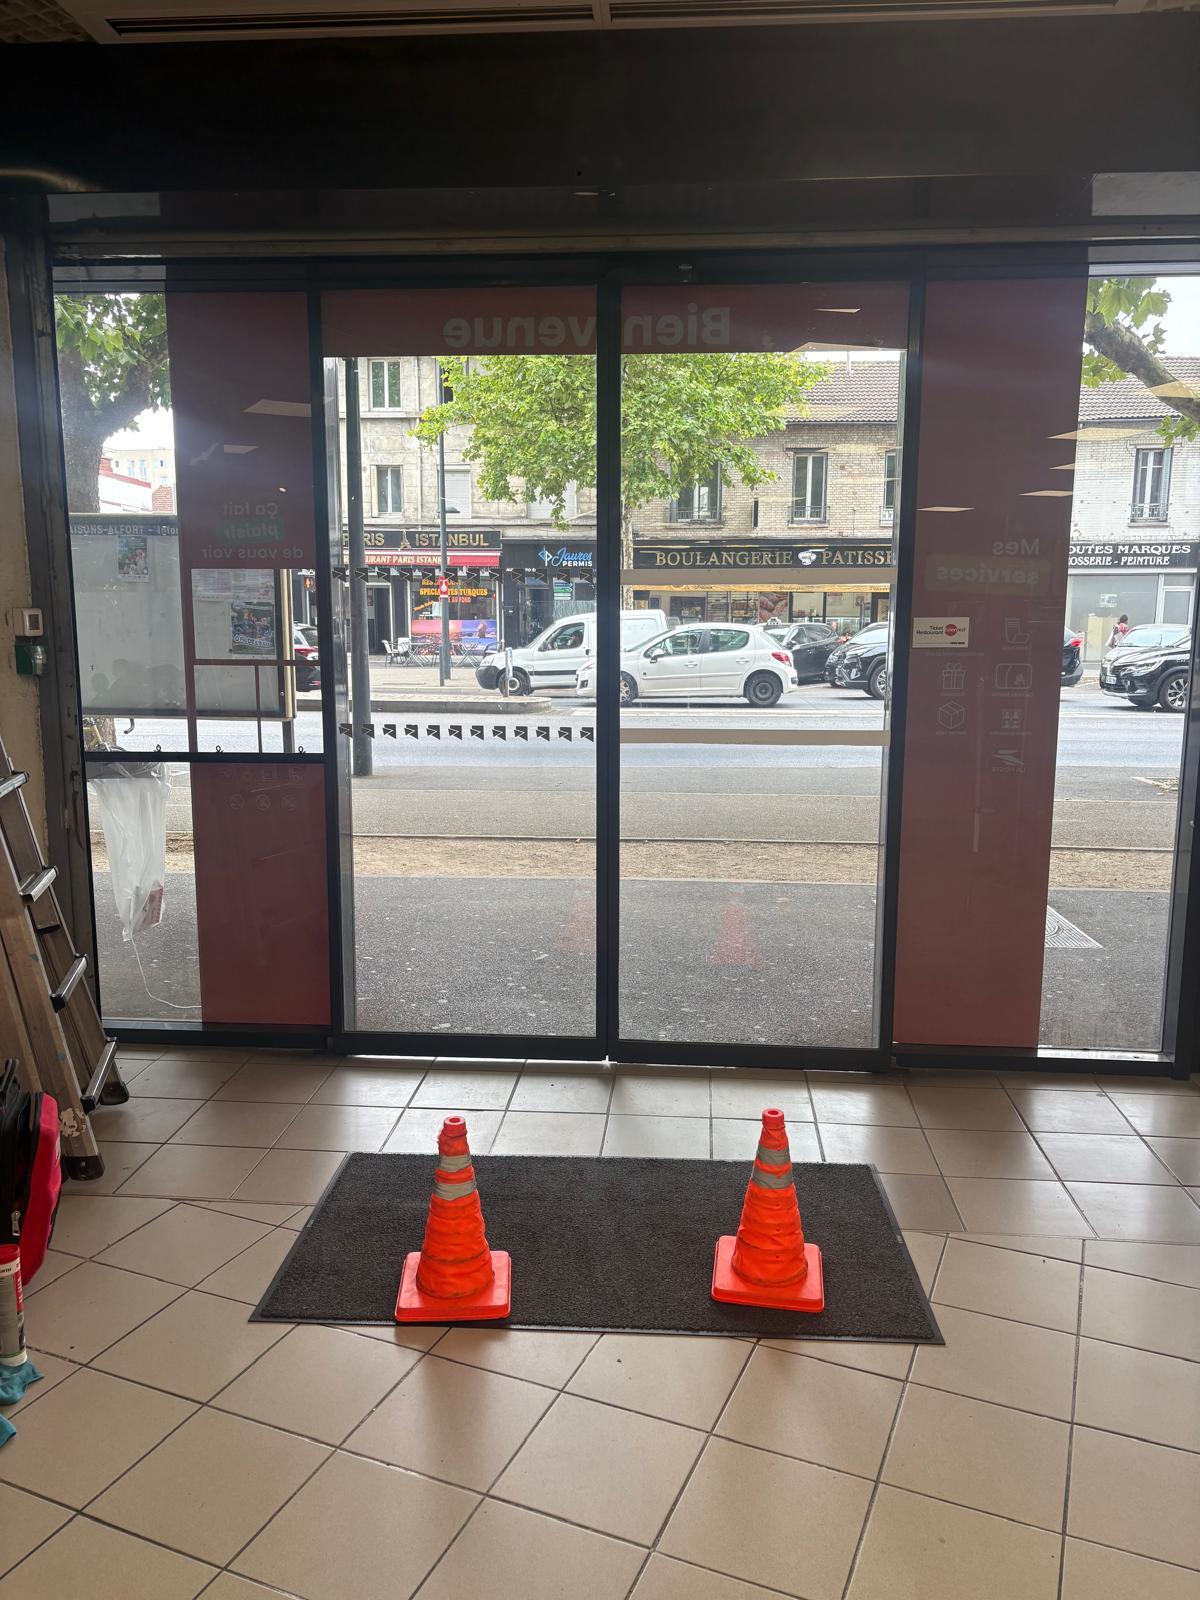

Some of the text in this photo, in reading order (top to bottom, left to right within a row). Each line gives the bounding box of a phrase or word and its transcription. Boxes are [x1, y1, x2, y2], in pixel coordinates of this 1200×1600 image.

[342, 533, 384, 546] PRIS
[1117, 545, 1191, 555] MARQUES
[343, 556, 394, 565] RURANT
[655, 551, 793, 566] BOULANGERIE
[1069, 557, 1112, 565] OSSERIE
[1120, 557, 1170, 566] PEINTURE
[419, 588, 488, 598] SPECITES TURQUES
